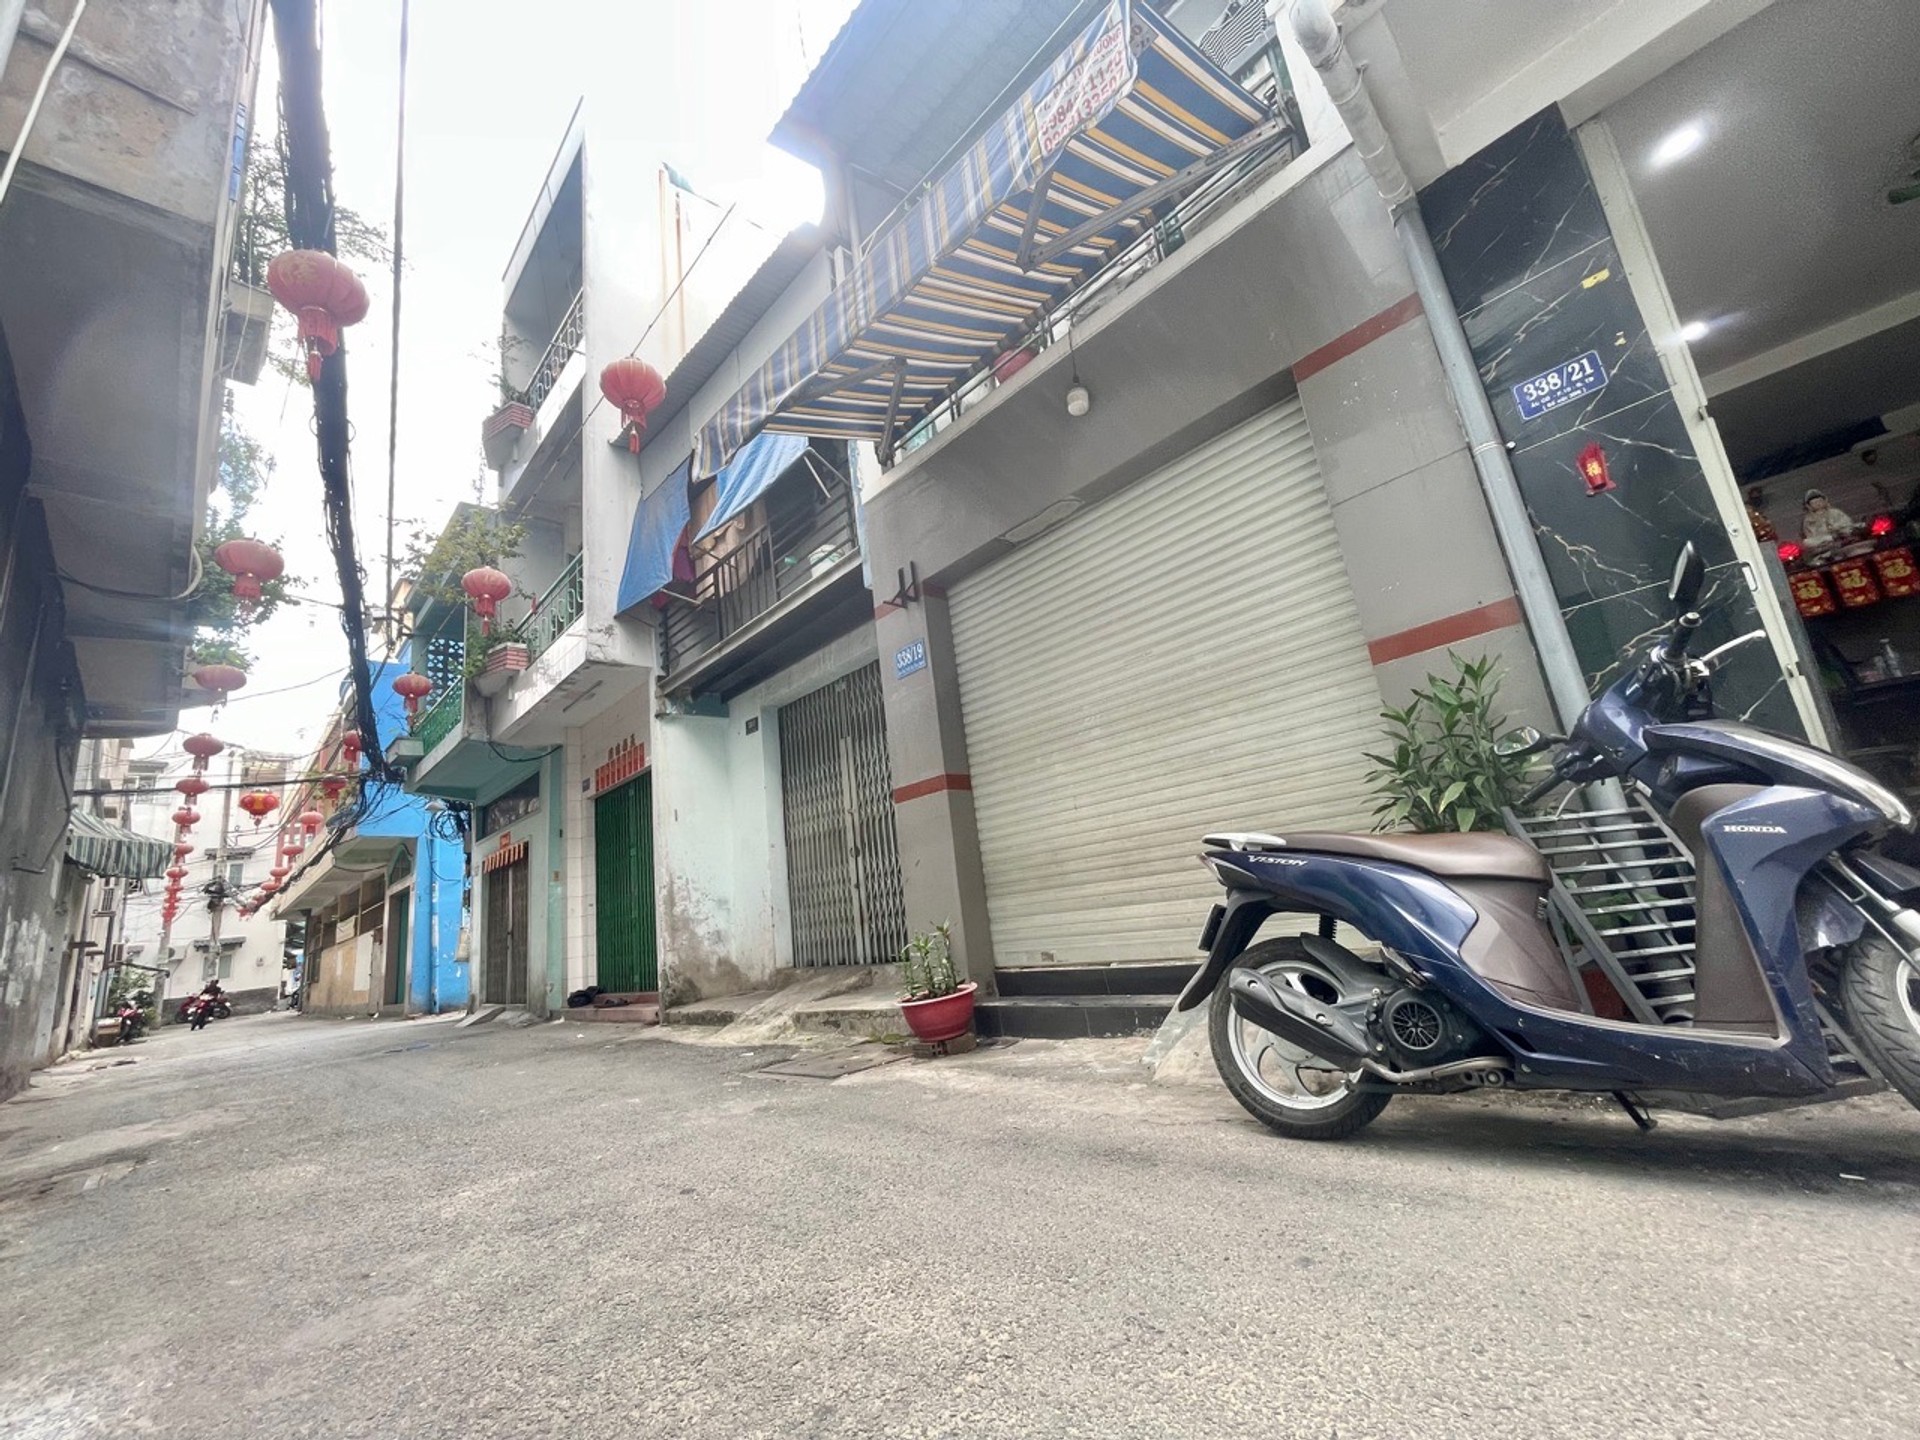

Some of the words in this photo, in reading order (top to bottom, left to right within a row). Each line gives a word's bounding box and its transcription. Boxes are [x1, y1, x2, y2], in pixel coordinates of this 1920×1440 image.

[1523, 358, 1594, 401] 338/21
[897, 643, 922, 669] 338/19
[1723, 825, 1788, 834] HONDA
[1247, 855, 1308, 867] VISION
